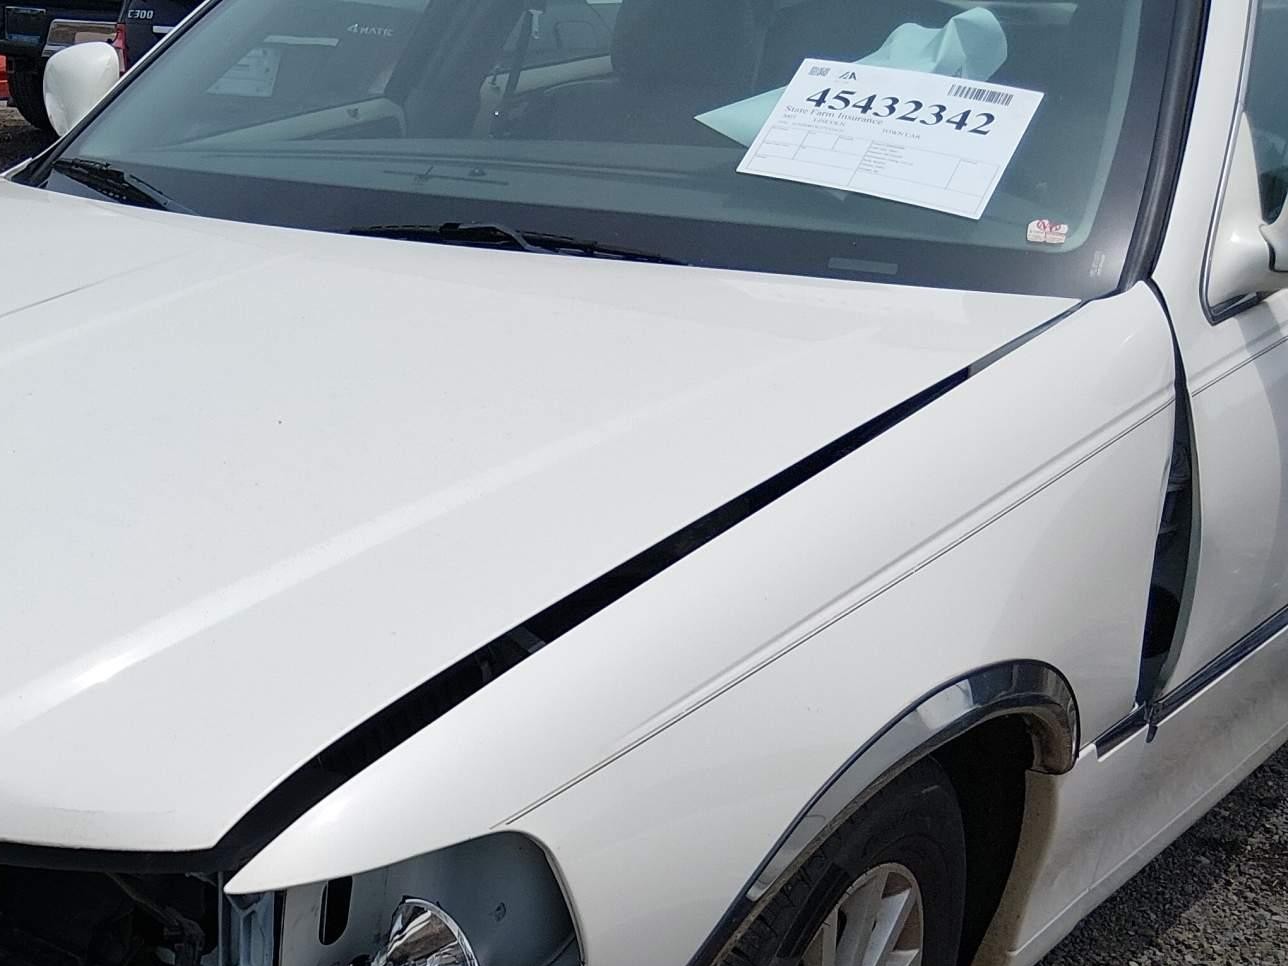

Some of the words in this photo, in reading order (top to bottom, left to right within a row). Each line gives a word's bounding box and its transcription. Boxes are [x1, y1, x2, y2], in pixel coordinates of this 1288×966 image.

[127, 9, 154, 19] C300
[785, 105, 809, 114] State
[811, 109, 835, 119] Farm
[837, 111, 884, 125] Insurance
[805, 87, 995, 136] 45432342
